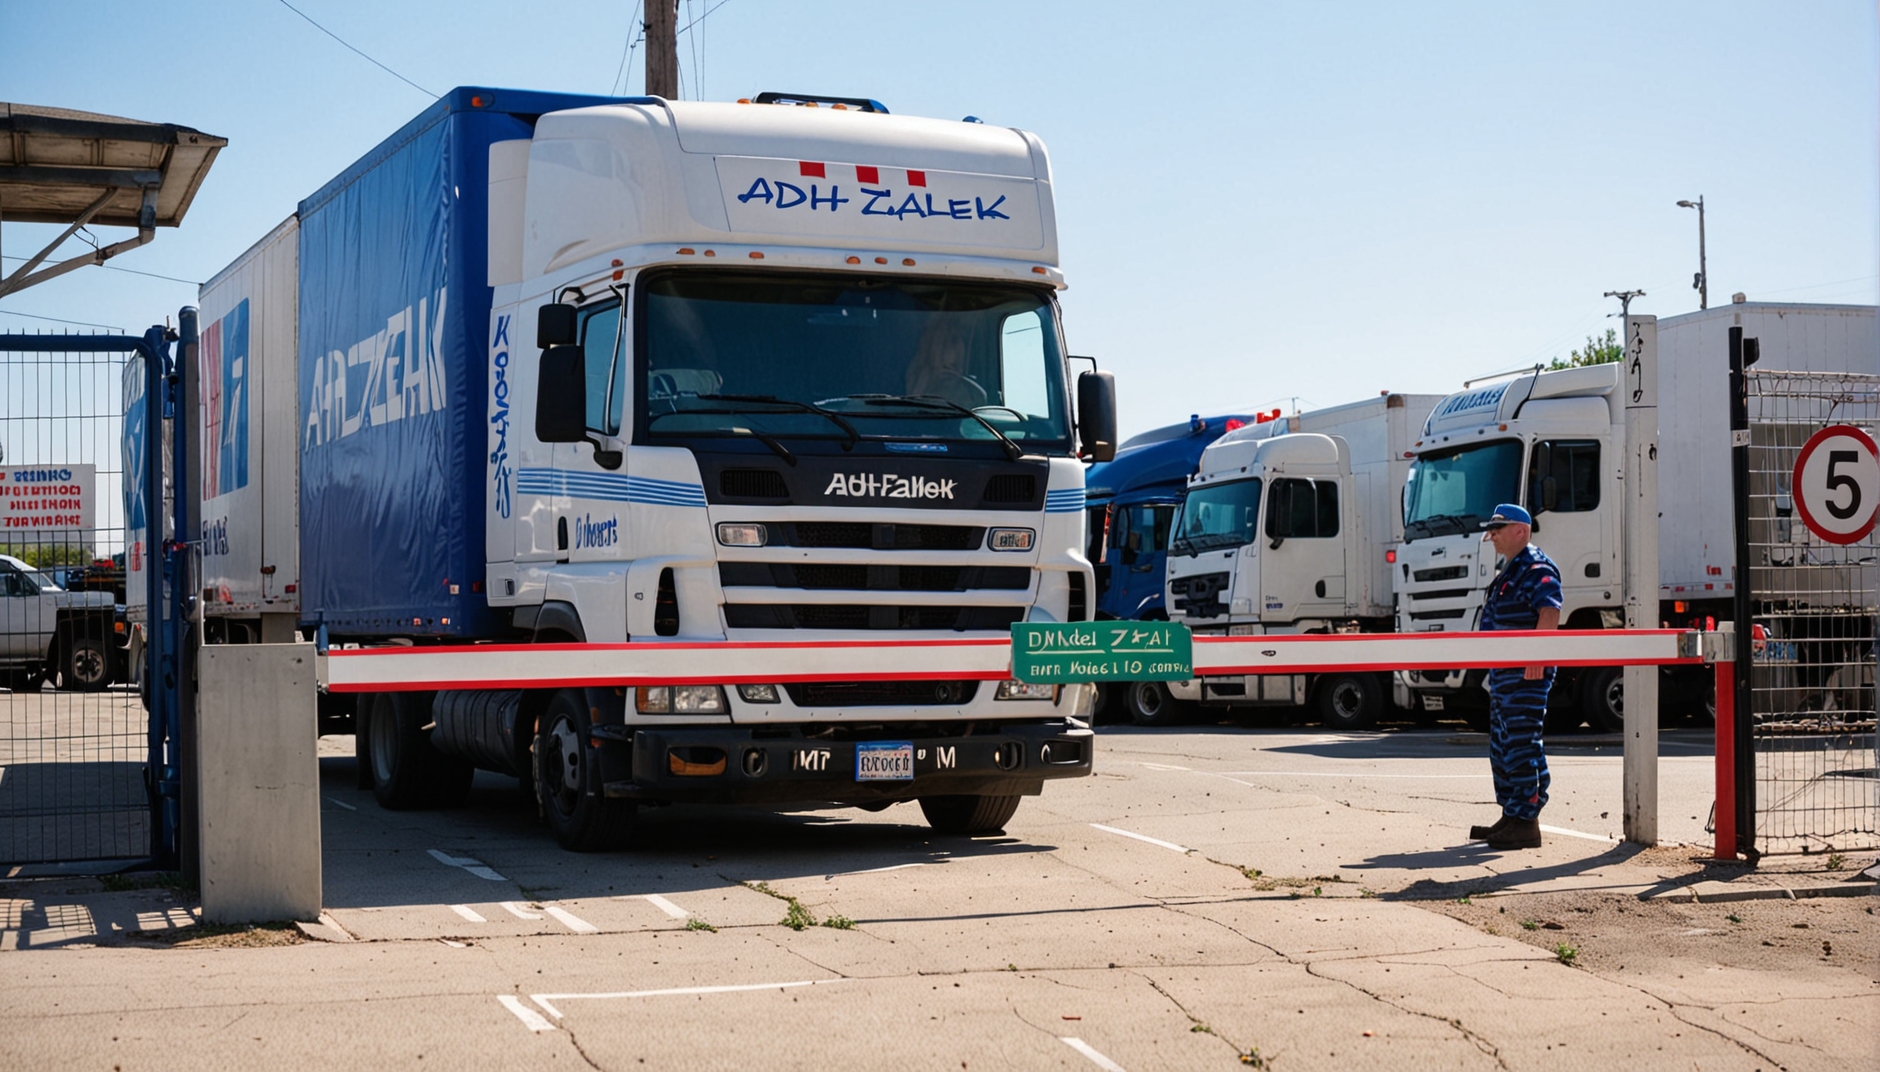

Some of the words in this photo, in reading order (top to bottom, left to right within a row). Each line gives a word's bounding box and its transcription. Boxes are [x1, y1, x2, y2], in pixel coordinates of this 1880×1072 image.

[737, 177, 849, 212] ADH
[860, 186, 1010, 221] ZALEK
[1825, 450, 1862, 520] 5
